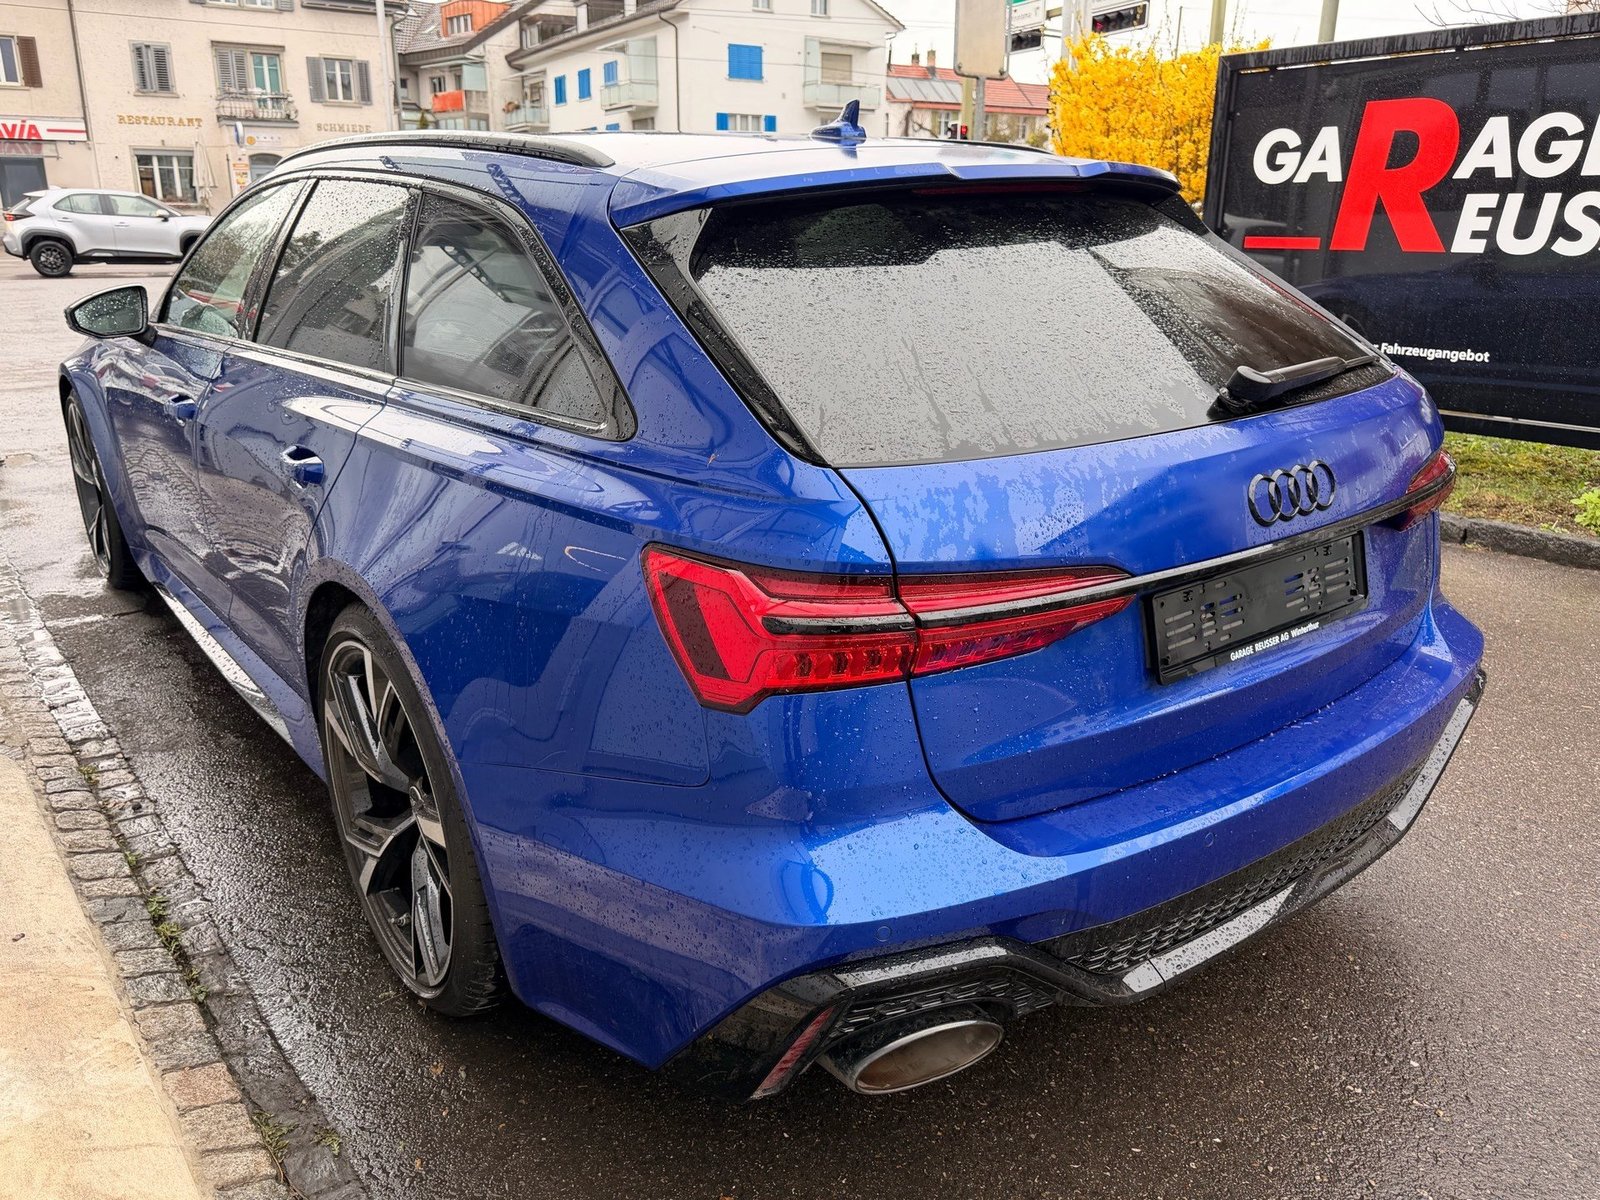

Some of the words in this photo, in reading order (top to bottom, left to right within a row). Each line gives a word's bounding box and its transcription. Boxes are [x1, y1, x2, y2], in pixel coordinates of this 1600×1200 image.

[0, 119, 43, 140] VIA
[116, 114, 203, 128] RESTAURANT
[316, 122, 372, 133] SCHMIEDE
[1380, 342, 1490, 363] Fahrzeugangebot
[1230, 645, 1254, 662] GARAGE
[1255, 635, 1280, 652] REUSSER
[1280, 631, 1290, 643] AG
[1290, 621, 1320, 638] Winterthur
